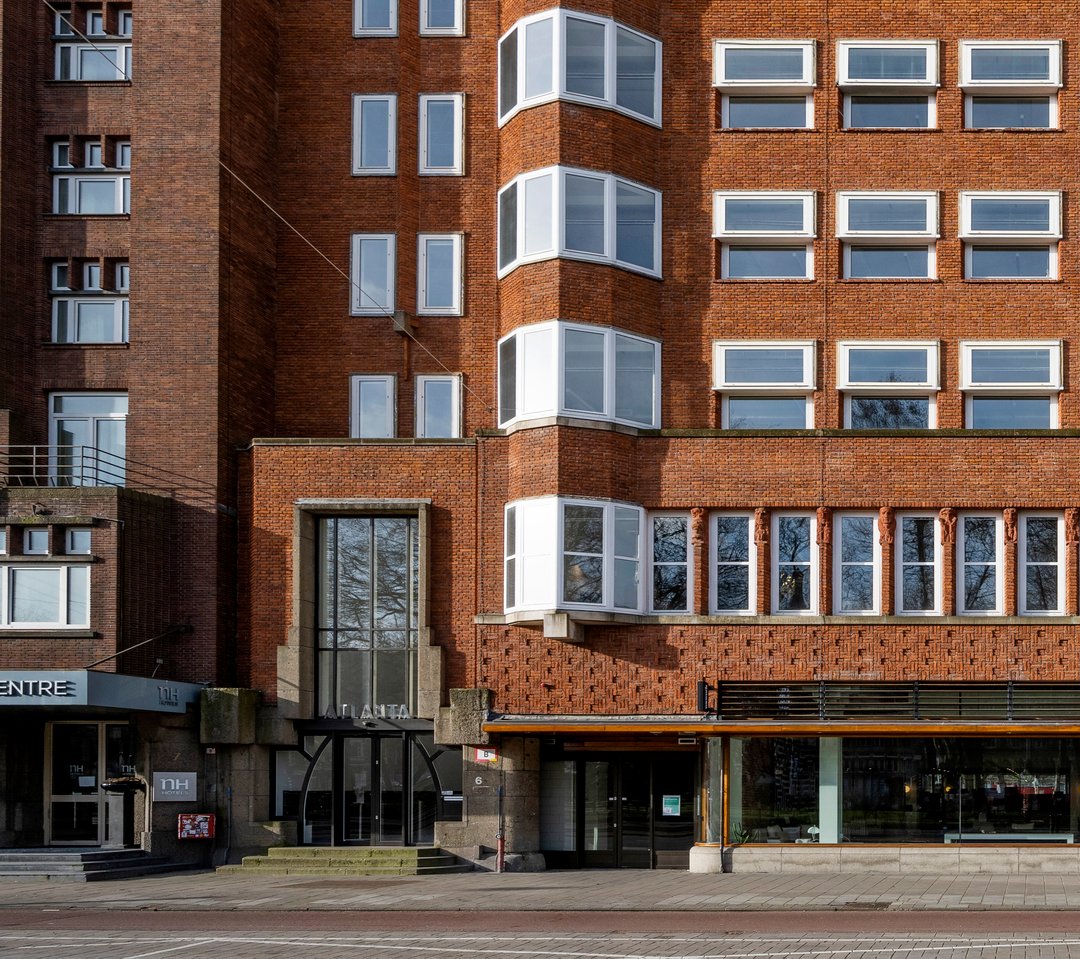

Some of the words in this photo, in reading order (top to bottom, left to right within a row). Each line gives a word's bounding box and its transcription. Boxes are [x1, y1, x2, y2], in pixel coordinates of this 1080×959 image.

[324, 703, 411, 720] ATLANTA
[483, 750, 489, 758] B
[475, 776, 483, 785] 6
